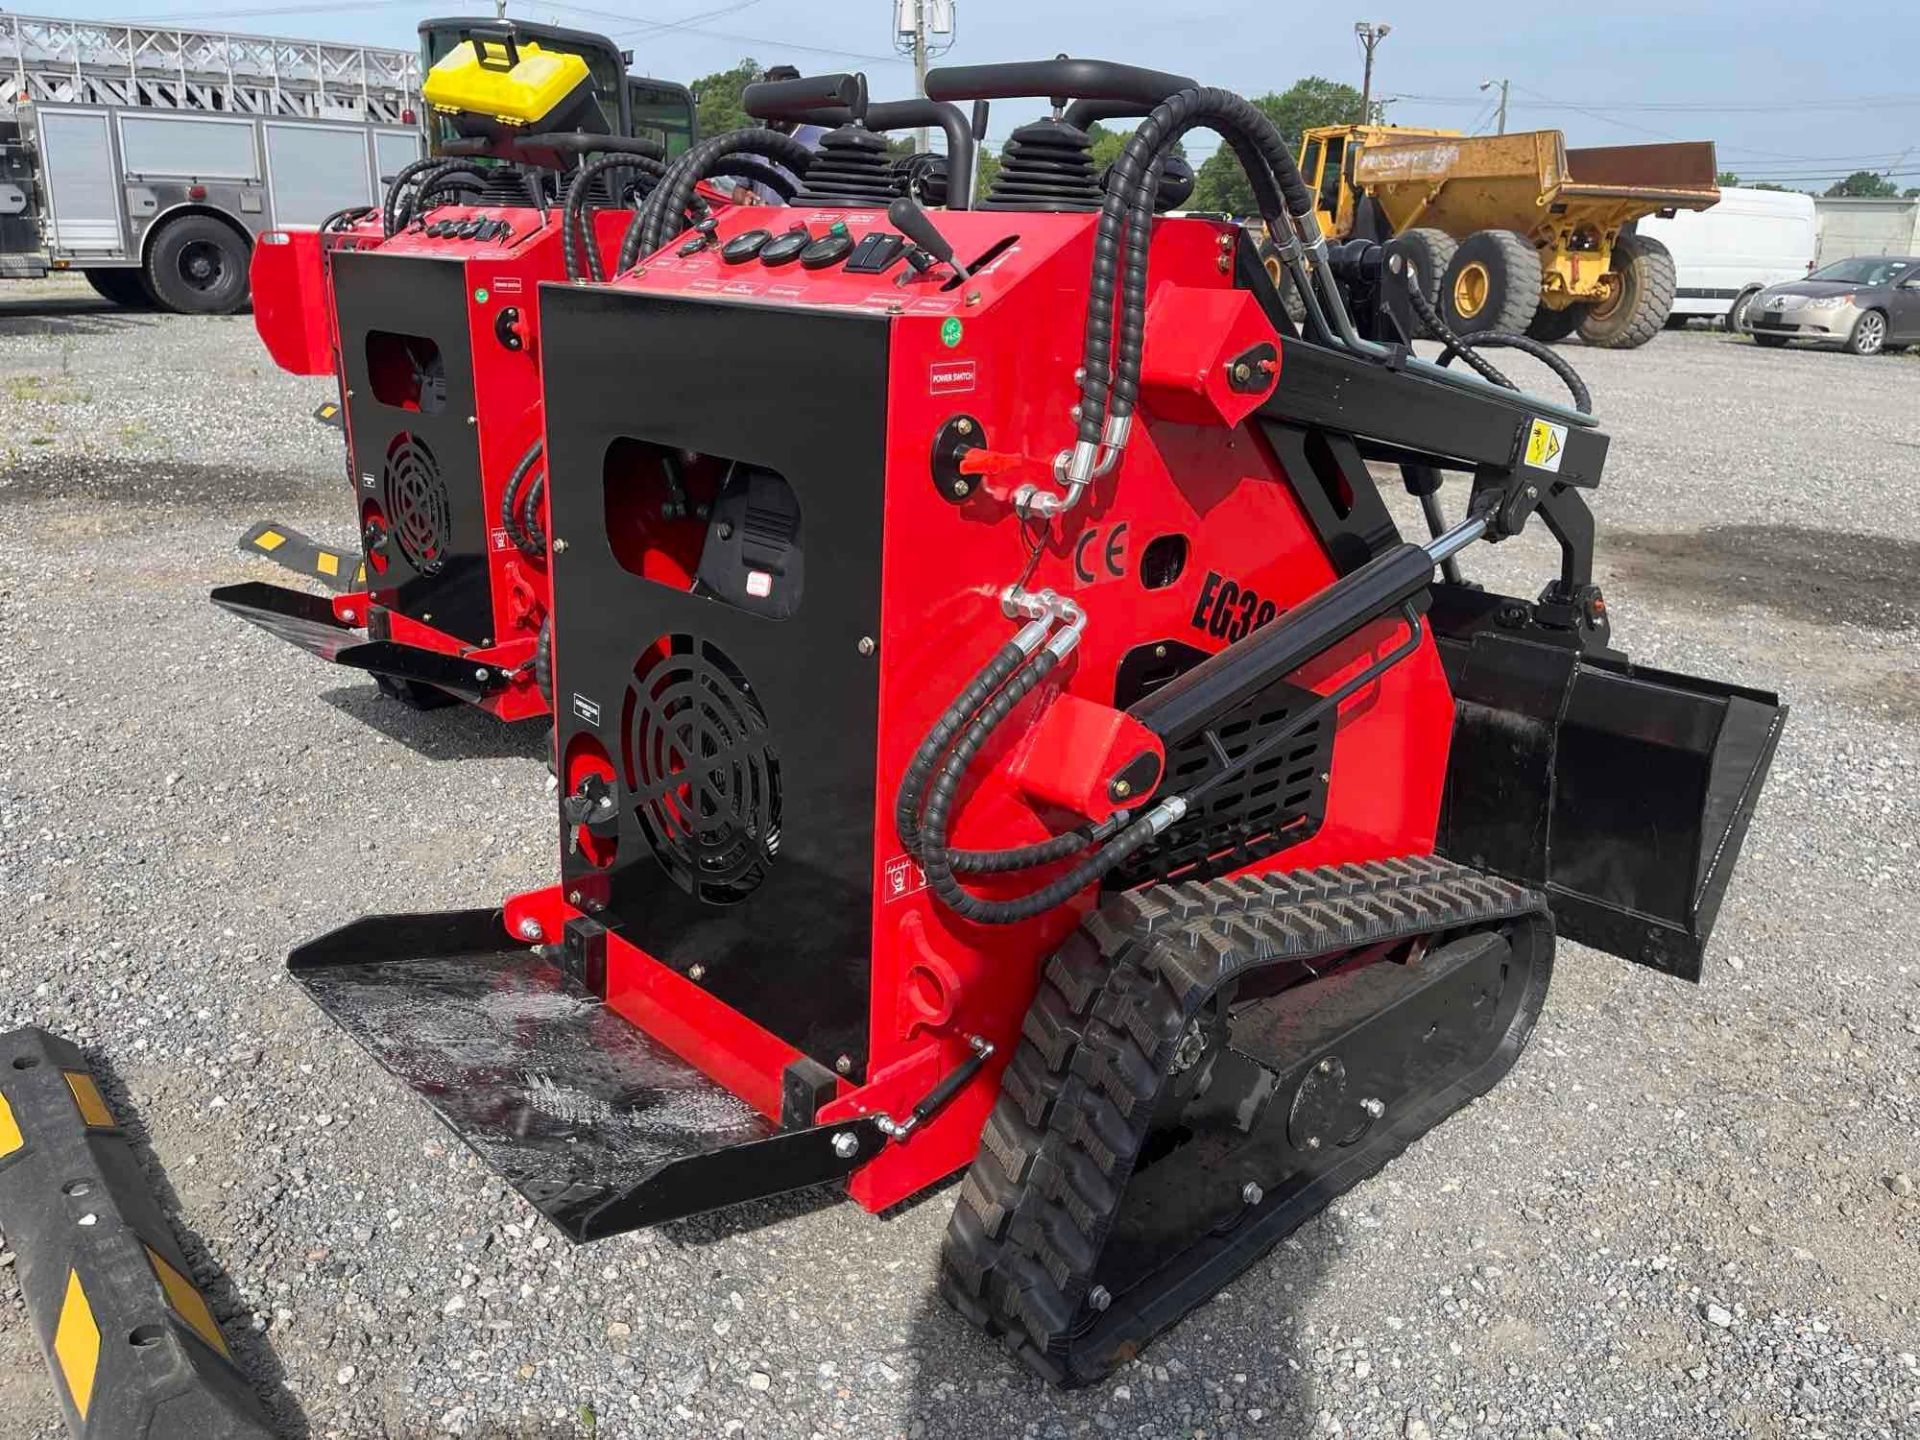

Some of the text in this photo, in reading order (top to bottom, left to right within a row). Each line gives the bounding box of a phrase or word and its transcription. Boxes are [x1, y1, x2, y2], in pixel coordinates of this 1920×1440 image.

[932, 372, 974, 383] POWER SWITCH
[1075, 522, 1128, 583] CE
[1191, 570, 1288, 645] EG38
